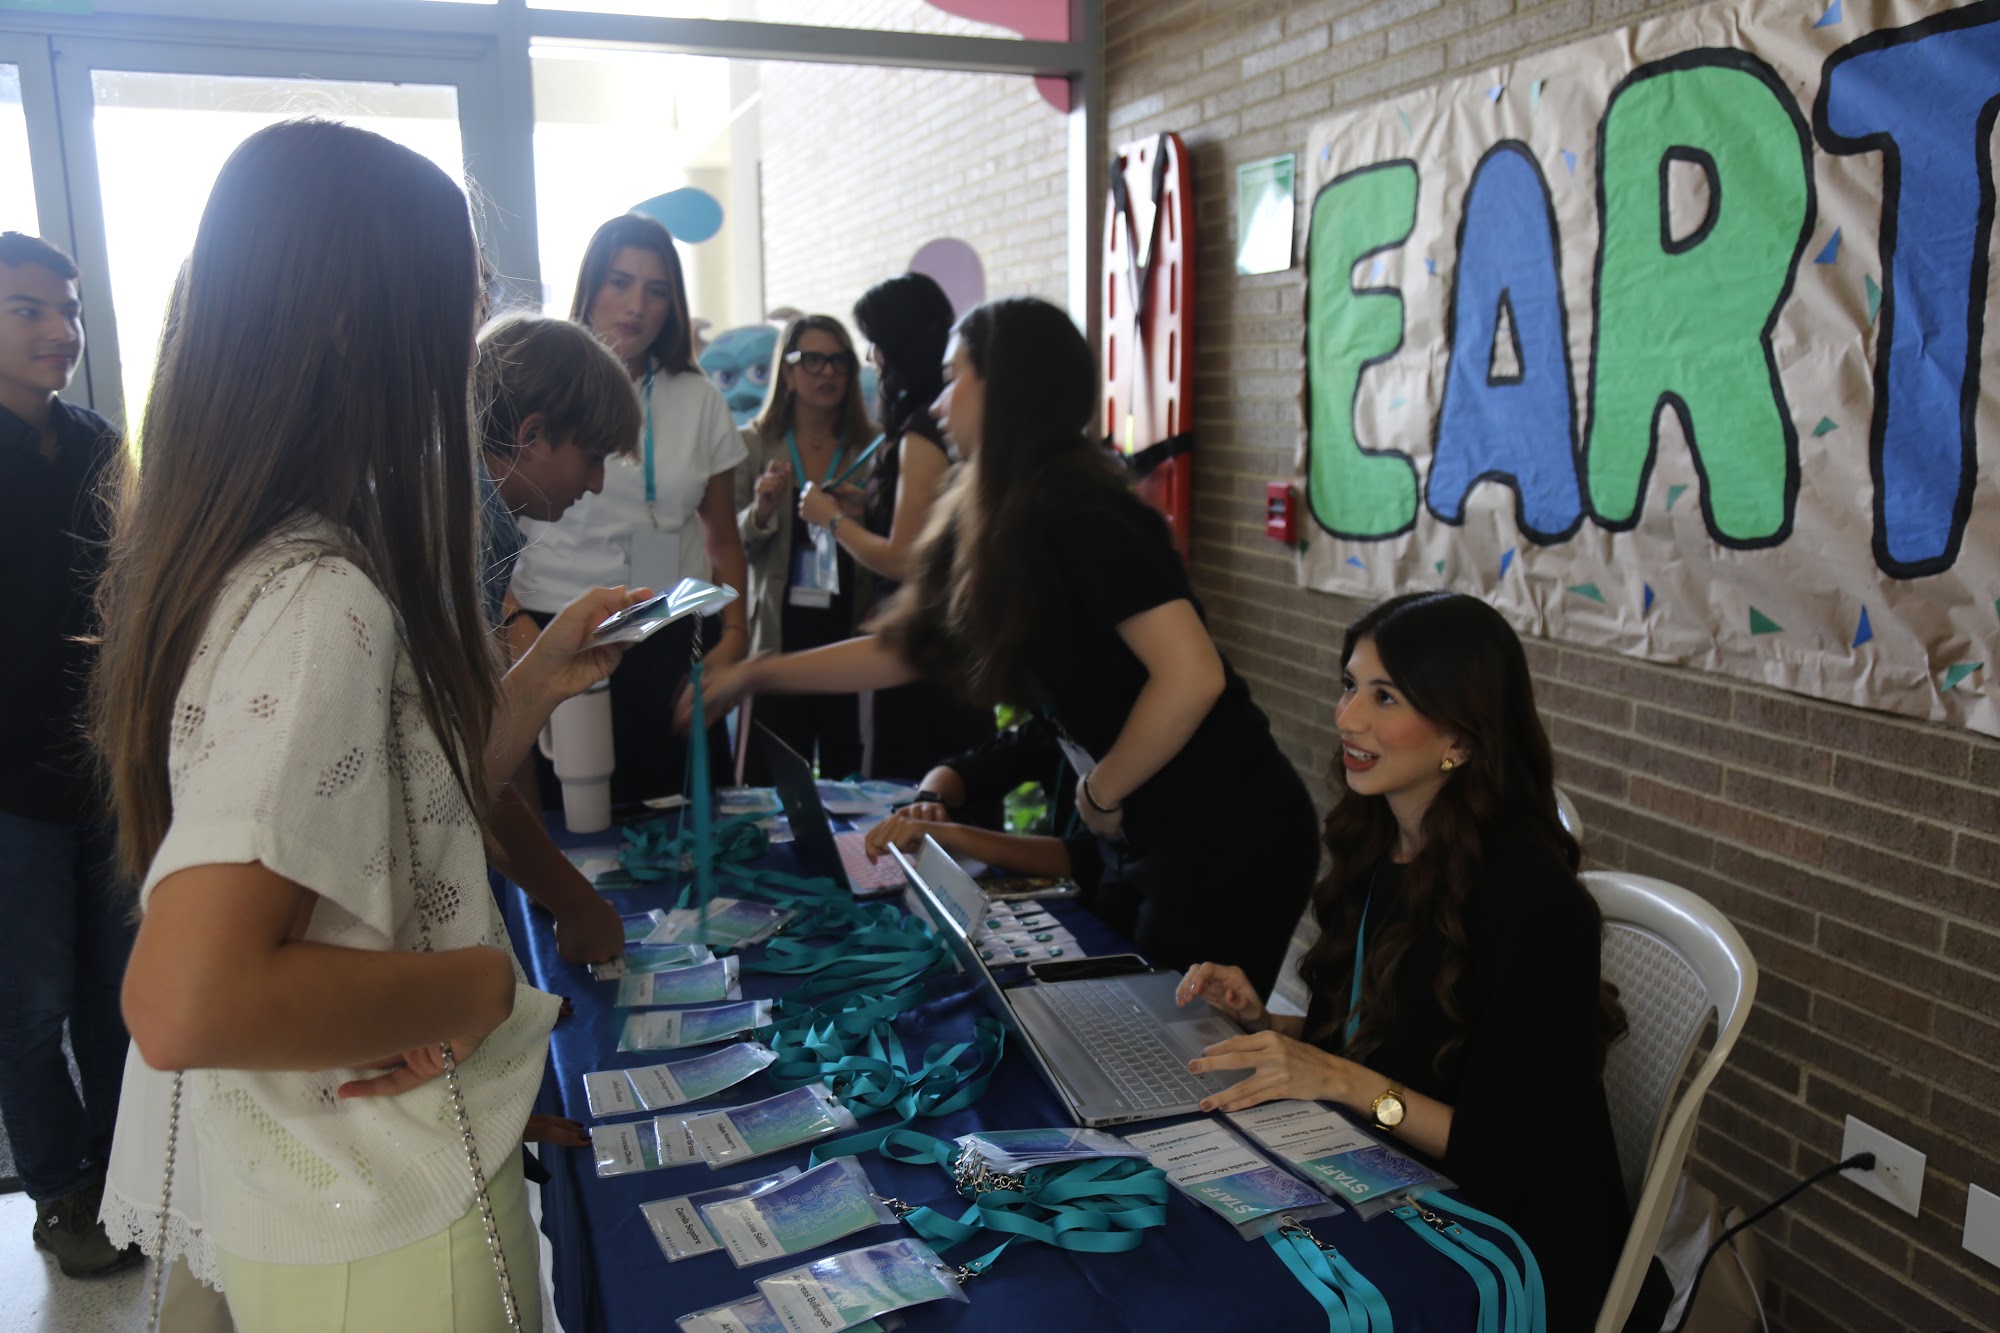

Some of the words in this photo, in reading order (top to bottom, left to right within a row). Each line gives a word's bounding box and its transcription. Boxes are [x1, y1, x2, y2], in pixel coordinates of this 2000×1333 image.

[1315, 1163, 1370, 1194] STAFF
[1201, 1187, 1252, 1214] STAFF
[675, 1207, 690, 1225] Camila
[740, 1211, 758, 1233] Catalina
[754, 1232, 769, 1249] Salah
